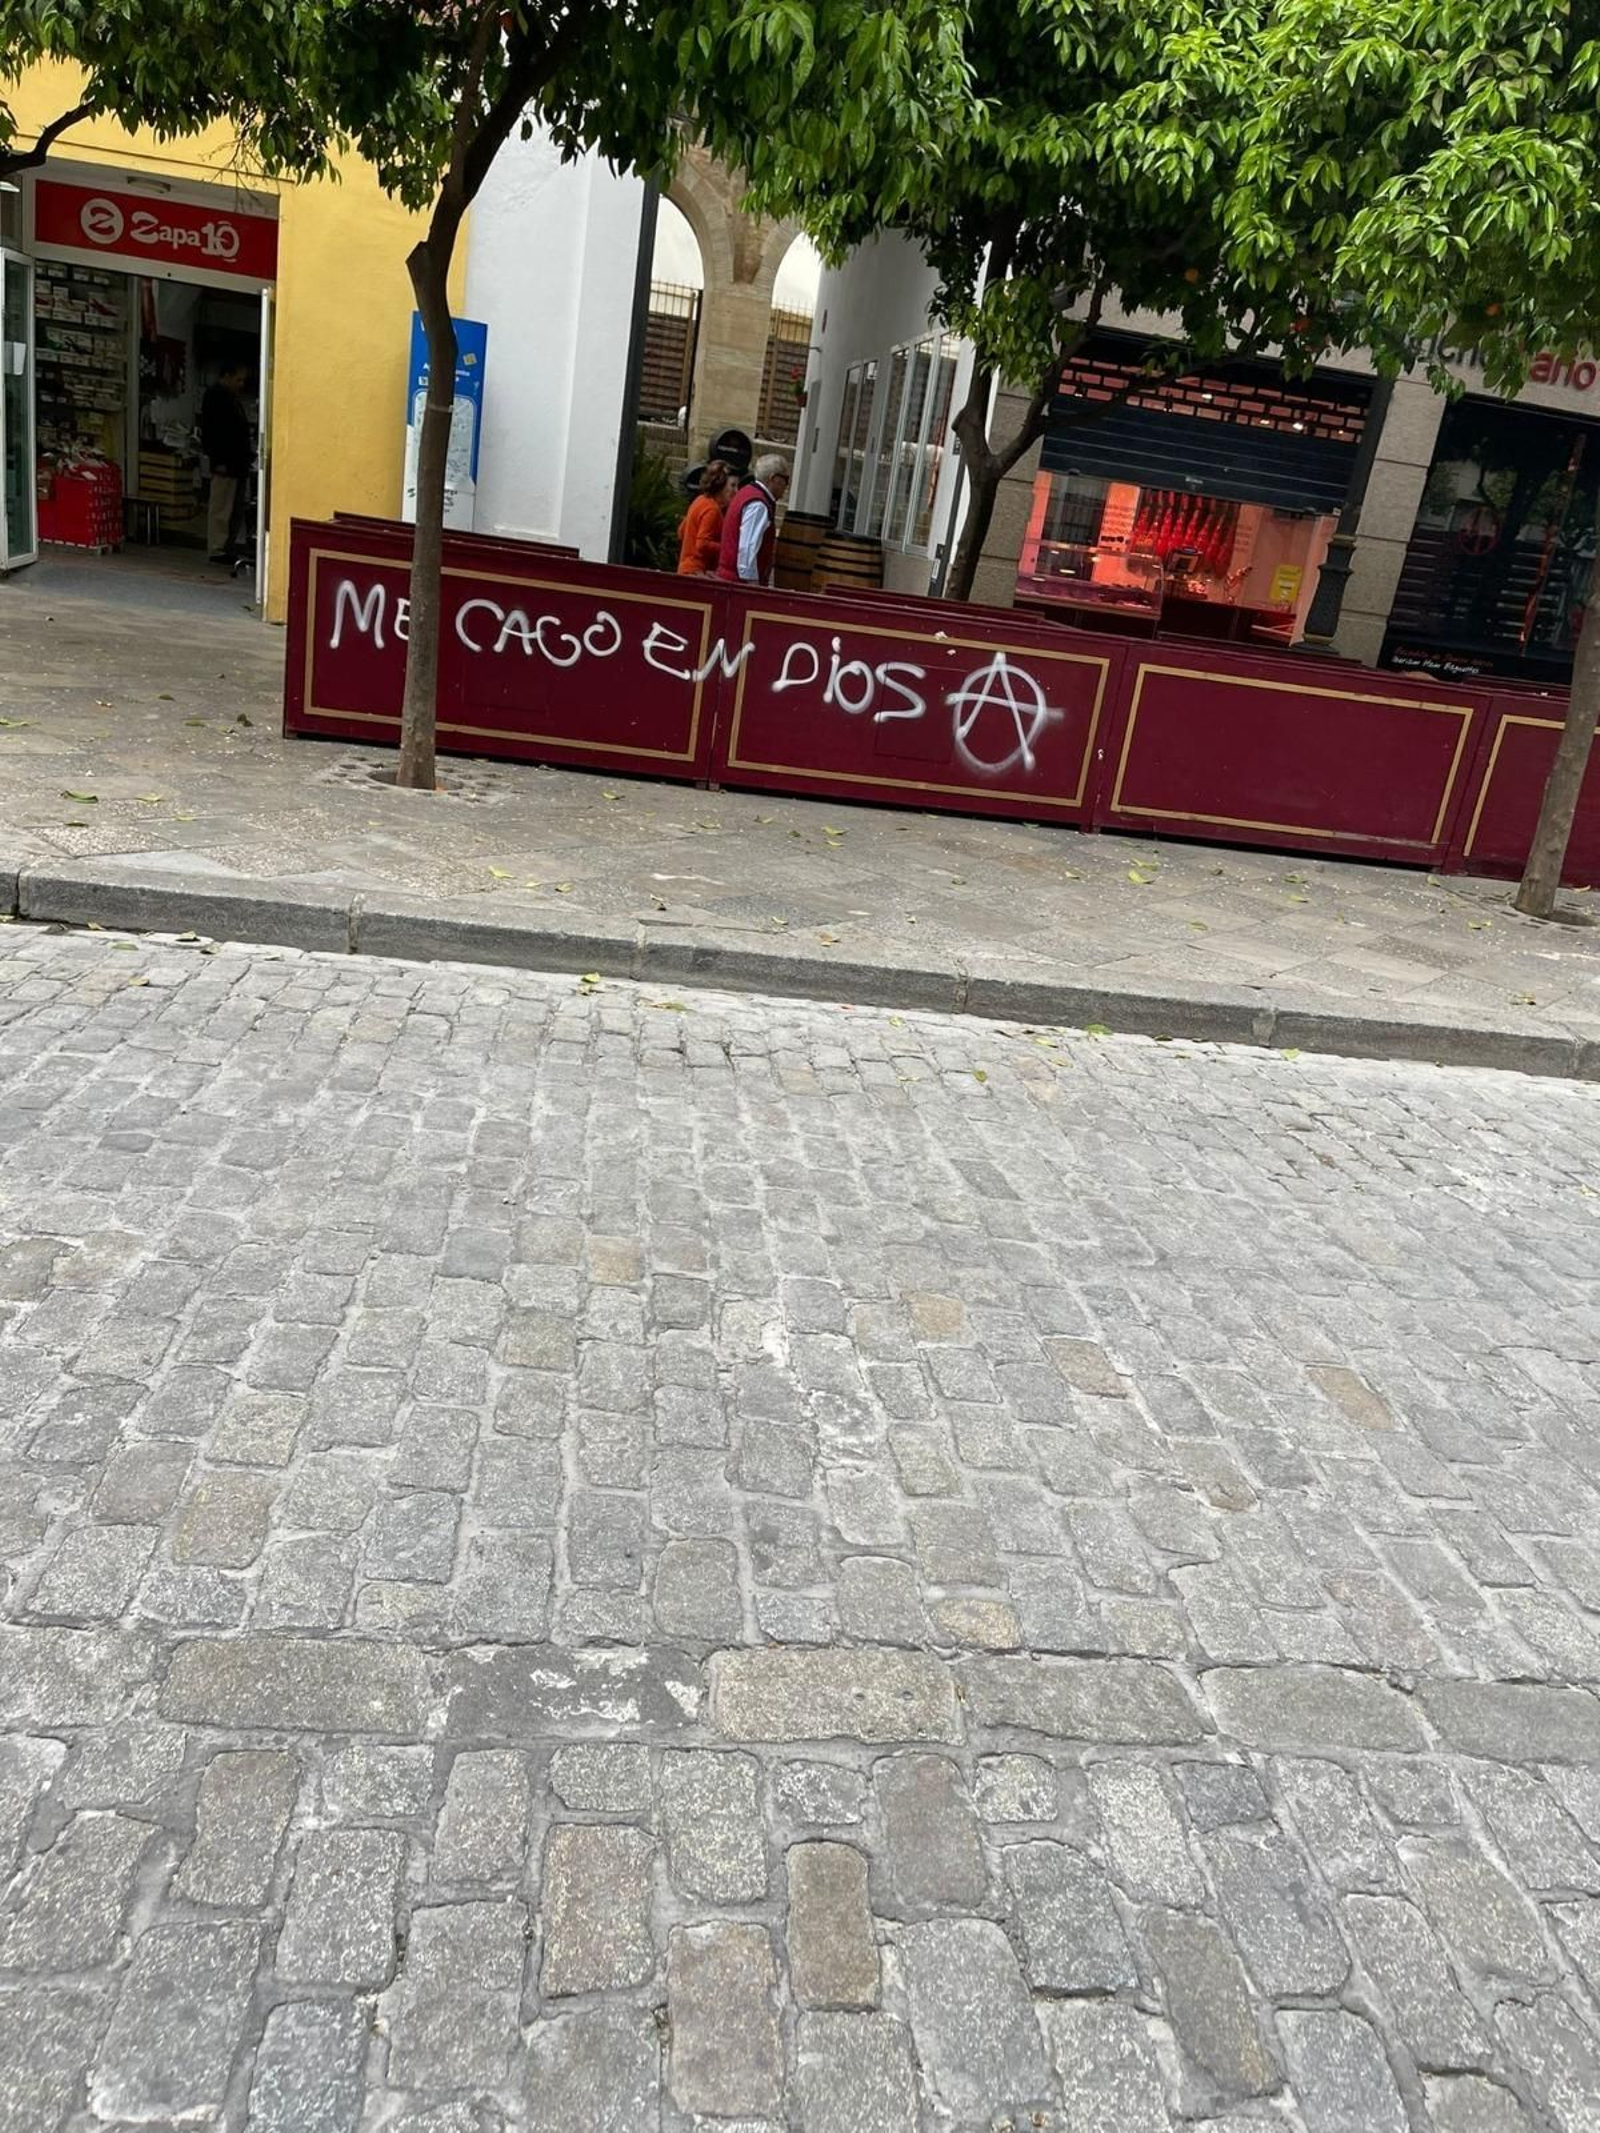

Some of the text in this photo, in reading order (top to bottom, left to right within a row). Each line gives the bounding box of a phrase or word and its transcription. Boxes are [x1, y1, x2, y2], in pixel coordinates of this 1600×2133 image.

[130, 211, 240, 262] Zapa10
[455, 599, 622, 667] CAGO
[642, 621, 756, 682] EN
